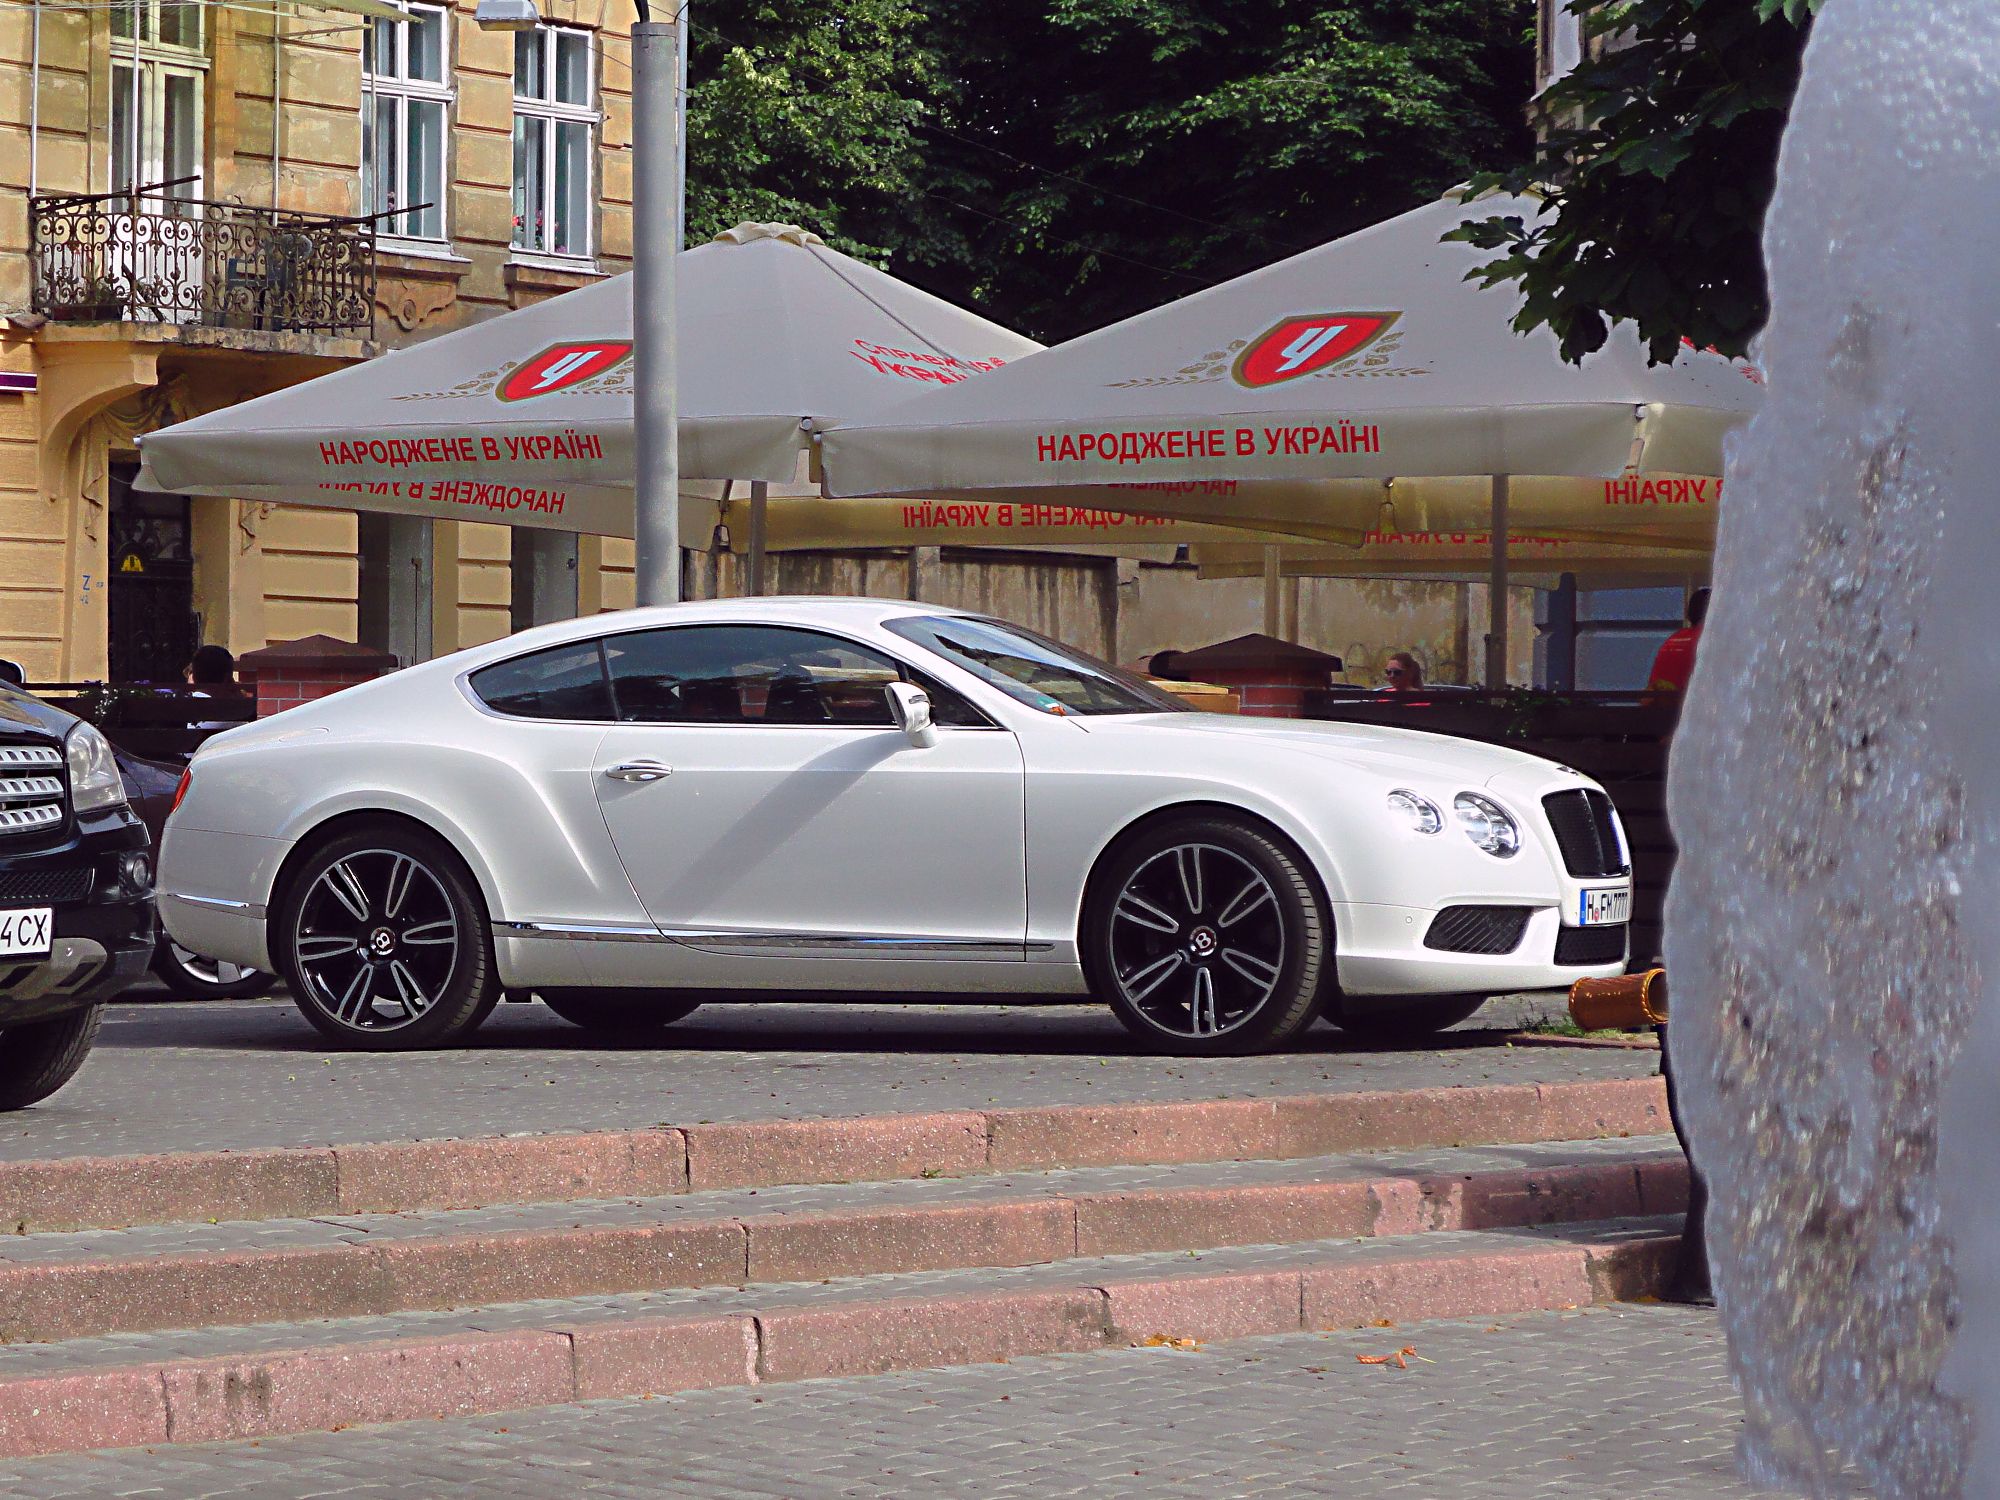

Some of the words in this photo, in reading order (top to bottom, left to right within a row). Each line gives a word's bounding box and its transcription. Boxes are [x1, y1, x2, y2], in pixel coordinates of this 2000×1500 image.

[319, 437, 478, 468] НАРОДЖЕНЕ
[481, 436, 501, 461] В
[504, 429, 603, 461] УКРАЇНІ
[1037, 429, 1226, 465] НАРОДЖЕНЕ
[1235, 428, 1256, 456] В
[1264, 419, 1381, 456] УКРАЇНІ
[17, 914, 48, 946] CX
